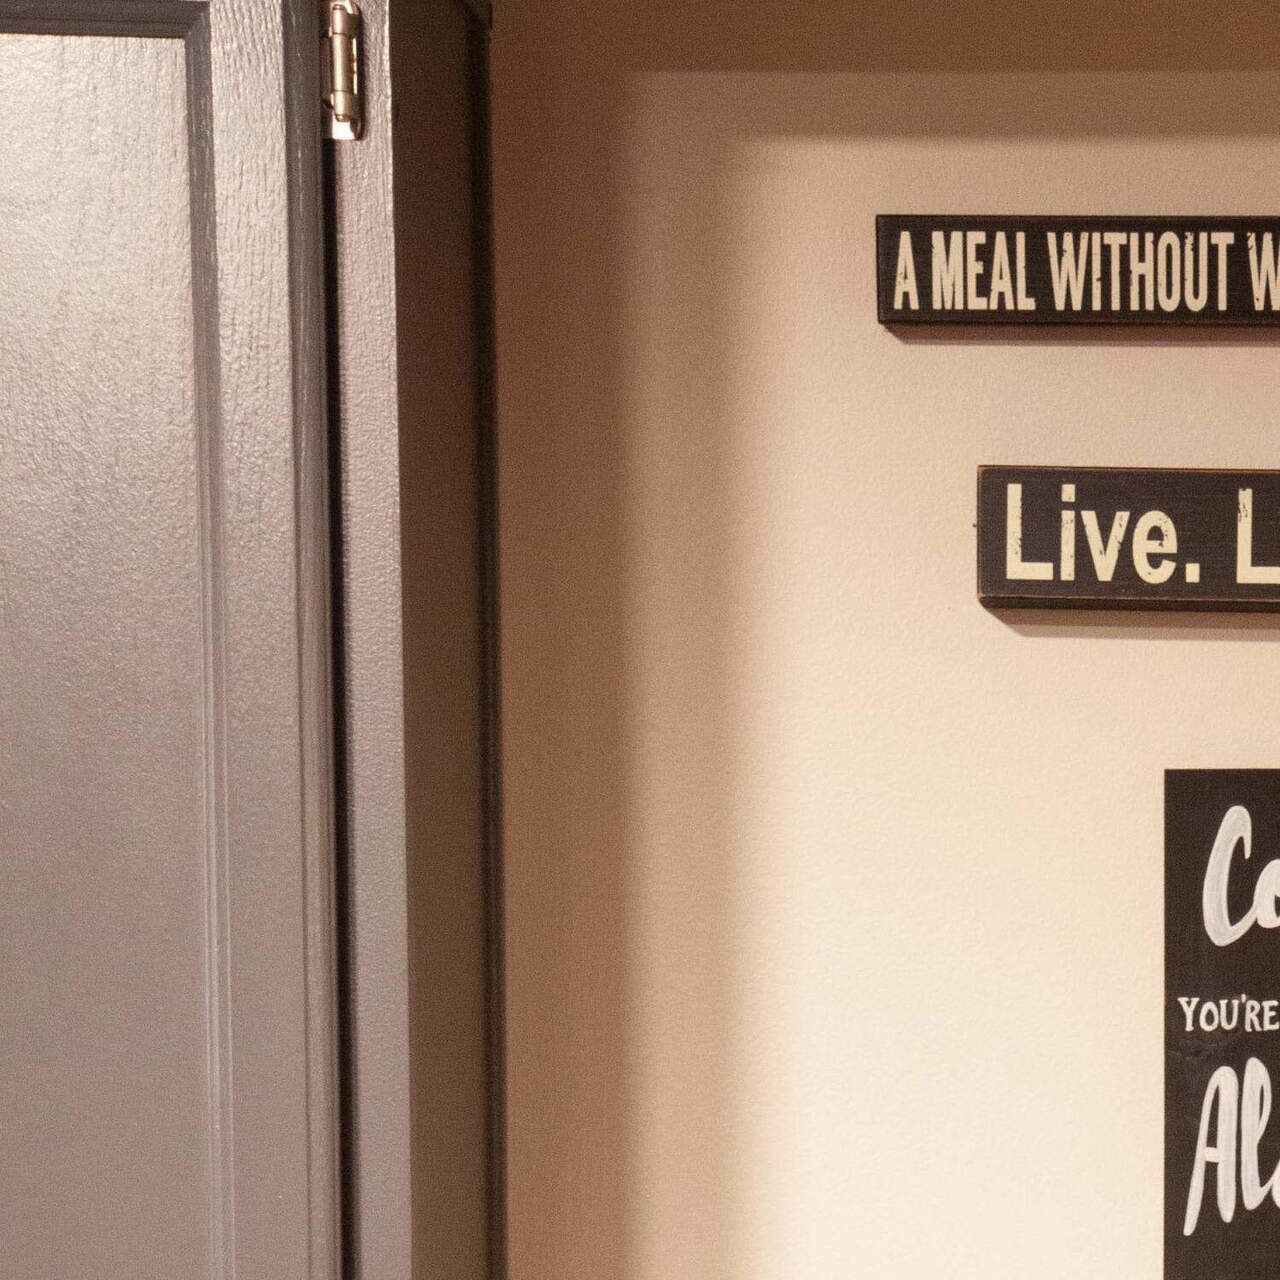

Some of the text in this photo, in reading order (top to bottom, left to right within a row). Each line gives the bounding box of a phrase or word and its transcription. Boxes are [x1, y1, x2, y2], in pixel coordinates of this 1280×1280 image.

[893, 230, 920, 311] A
[931, 230, 1036, 311] MEAL
[1047, 230, 1235, 312] WITHOUT
[1005, 482, 1201, 584] Live.
[1177, 994, 1280, 1032] YOU'RE
